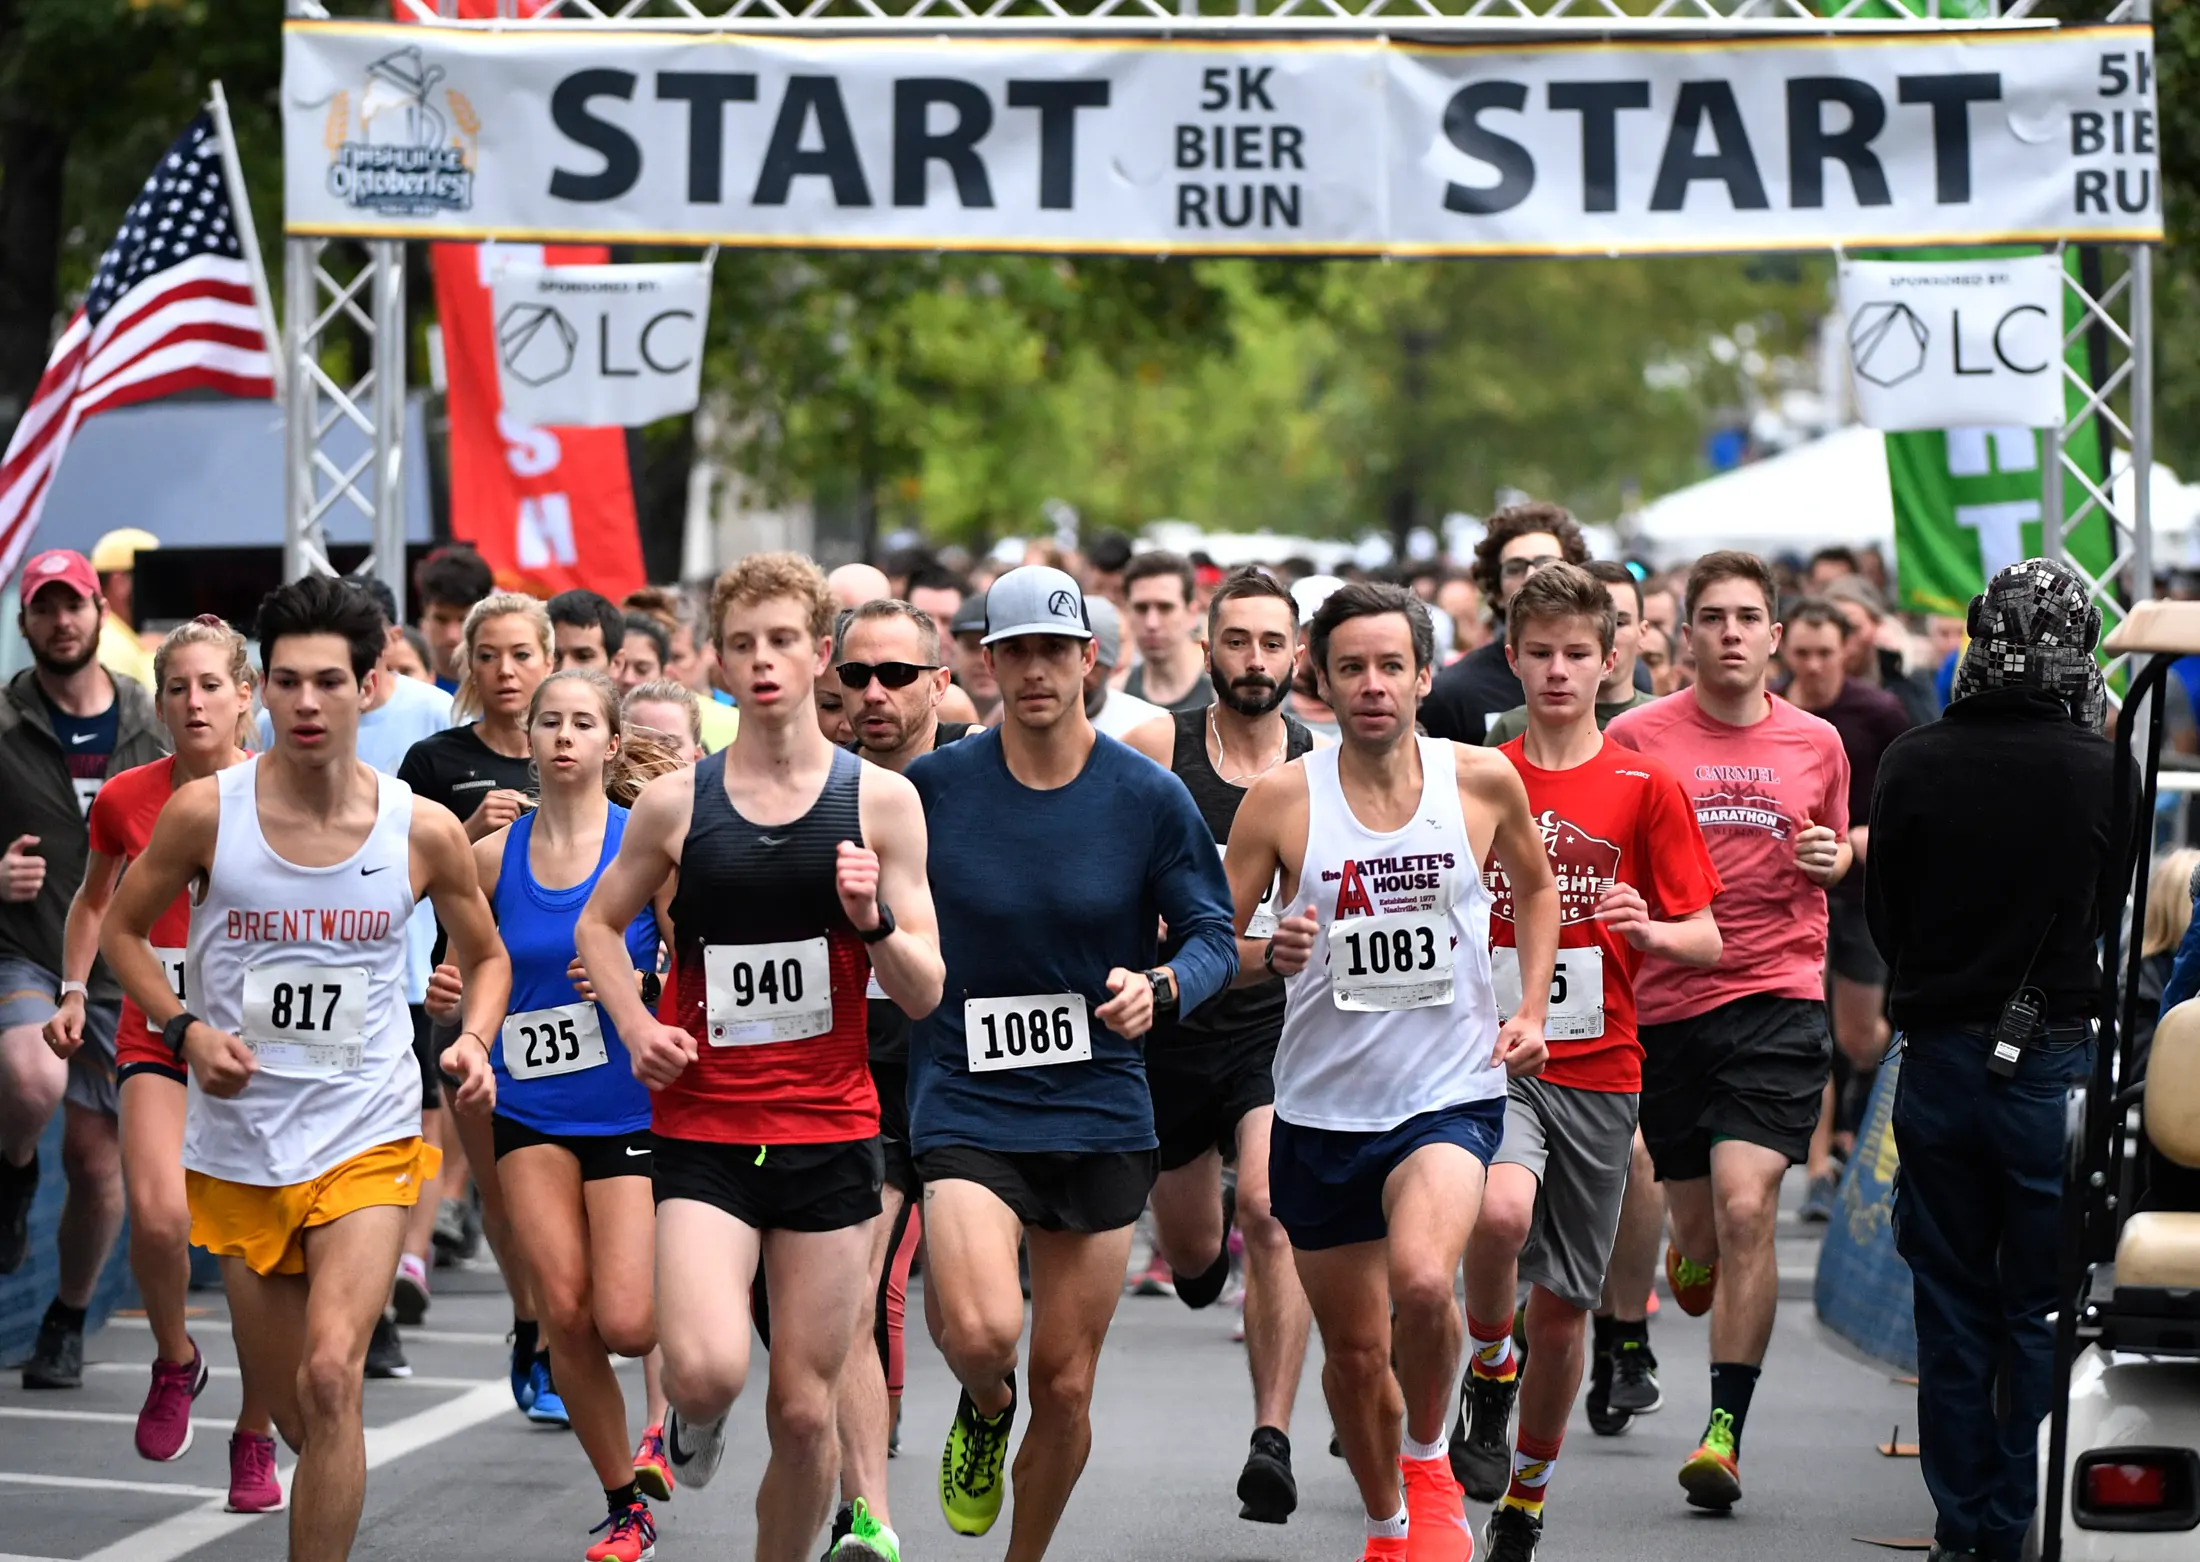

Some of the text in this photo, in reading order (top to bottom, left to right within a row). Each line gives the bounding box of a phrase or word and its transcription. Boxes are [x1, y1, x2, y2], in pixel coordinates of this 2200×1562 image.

[1201, 66, 1275, 111] 5K
[548, 68, 1111, 211] START
[1175, 124, 1306, 170] BIER
[1442, 72, 2001, 215] START
[1176, 184, 1301, 228] RUN
[599, 310, 697, 377] LC
[1952, 304, 2049, 375] LC
[1695, 765, 1781, 785] CARMEL
[1697, 809, 1778, 828] MARATHON
[1321, 870, 1341, 882] the
[1356, 853, 1456, 877] ATHLETE'S
[1373, 873, 1440, 894] HOUSE
[1379, 895, 1418, 906] Established
[1384, 903, 1432, 914] Nashville, TN
[228, 909, 390, 942] BRENTWOOD
[1345, 926, 1436, 976] 1083
[733, 958, 803, 1007] 940
[271, 983, 342, 1031] 817
[519, 1018, 580, 1068] 235
[981, 1006, 1074, 1060] 1086
